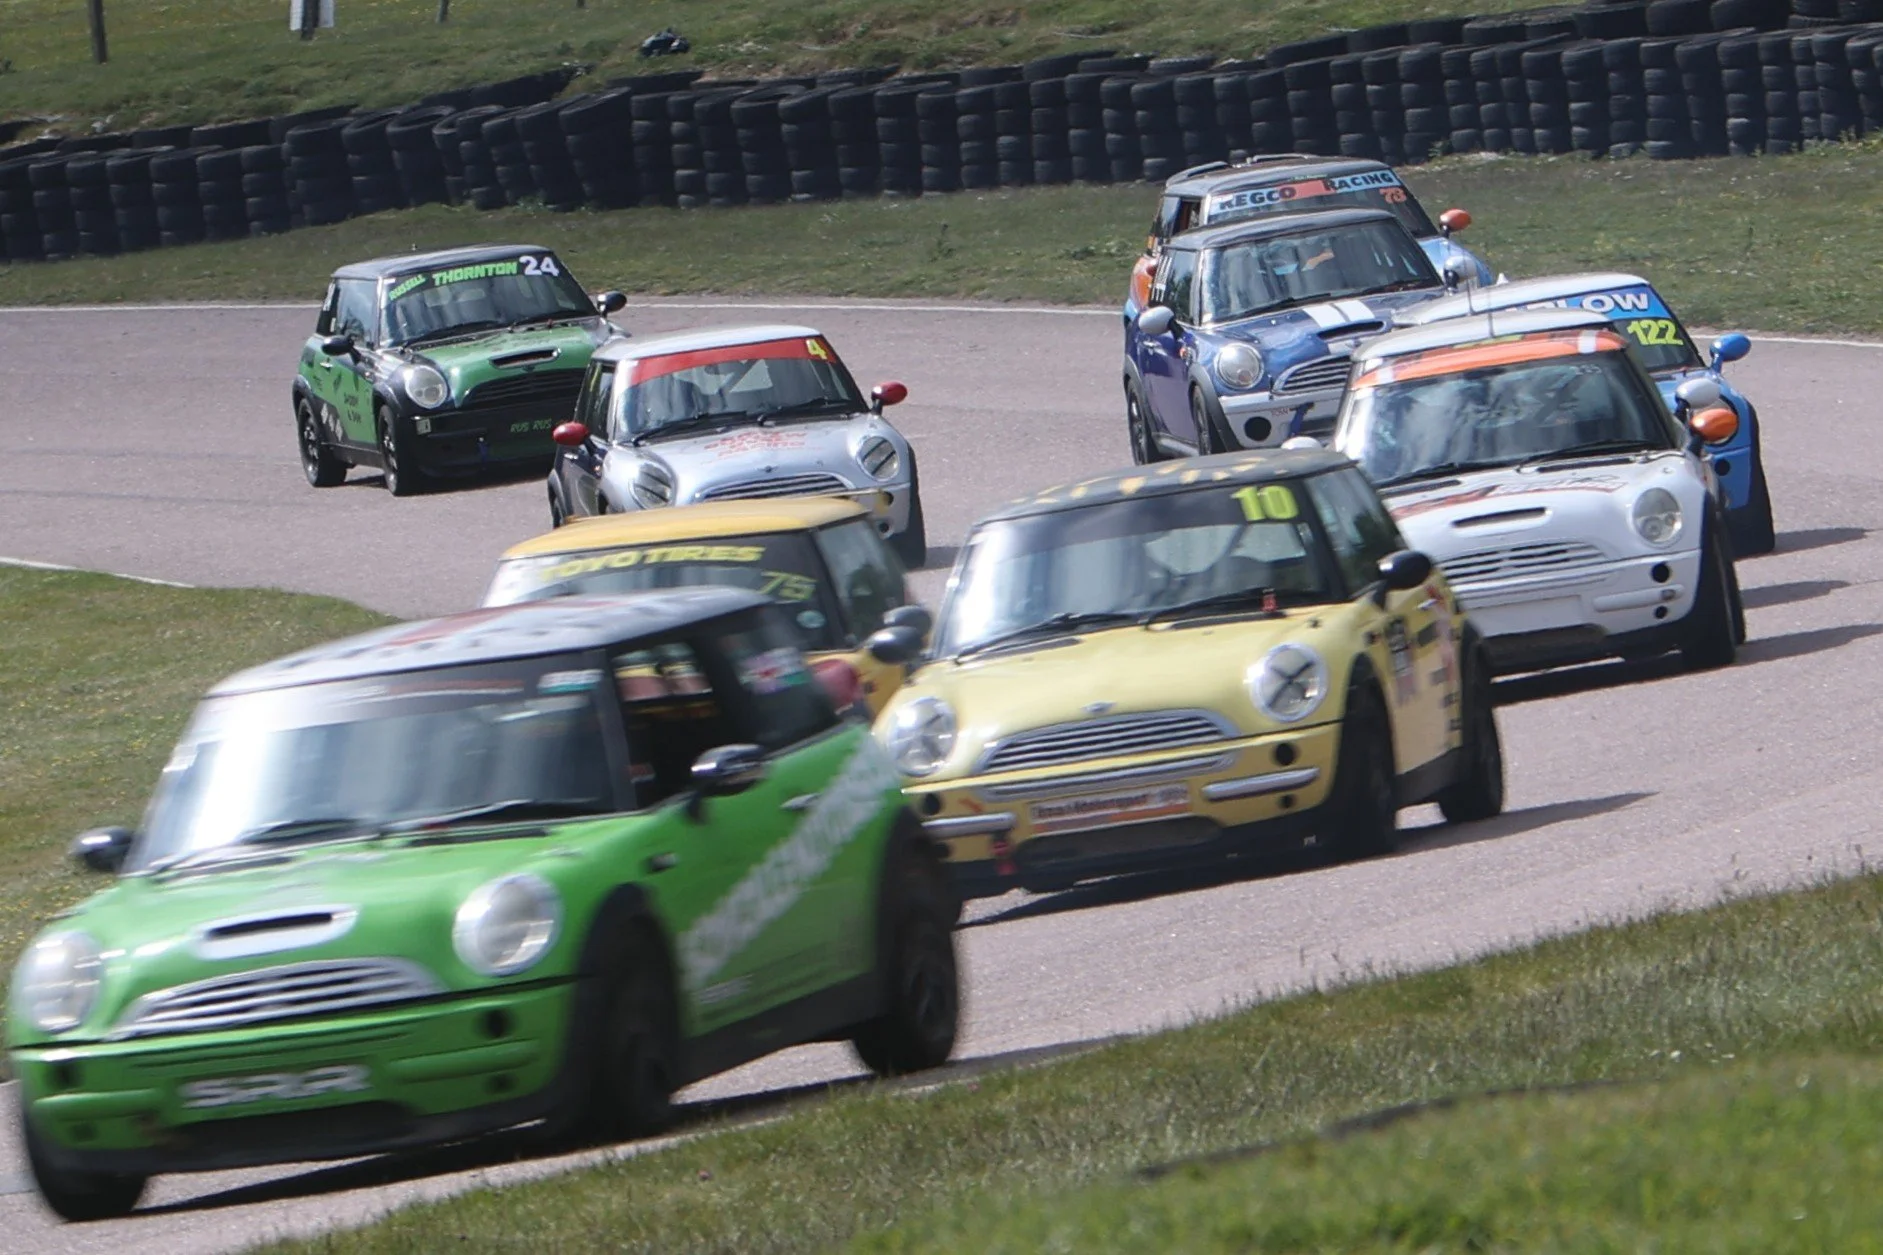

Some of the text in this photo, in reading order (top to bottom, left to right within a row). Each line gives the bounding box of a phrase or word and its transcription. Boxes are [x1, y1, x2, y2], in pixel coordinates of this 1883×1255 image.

[1323, 172, 1395, 192] RACING
[432, 261, 518, 287] THORNTON
[519, 255, 560, 277] 24
[1626, 319, 1684, 346] 122
[805, 338, 828, 360] 4
[1230, 485, 1299, 520] 10
[644, 545, 766, 565] TIRES
